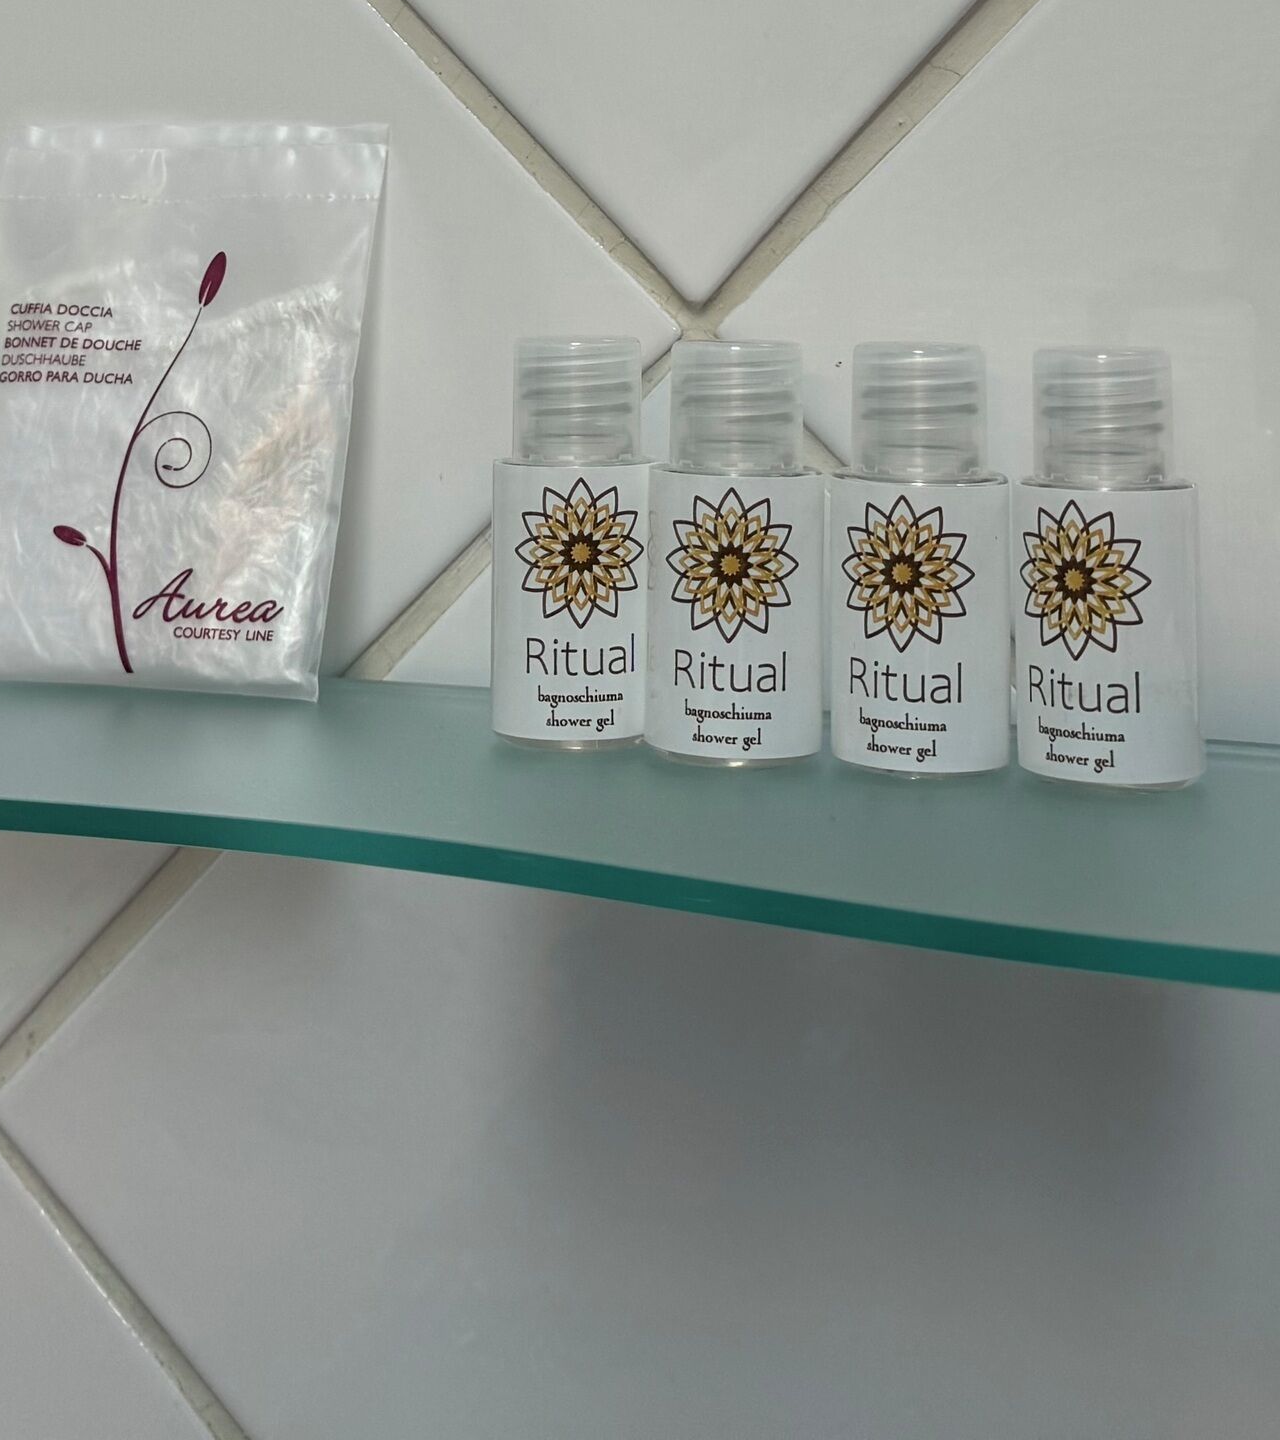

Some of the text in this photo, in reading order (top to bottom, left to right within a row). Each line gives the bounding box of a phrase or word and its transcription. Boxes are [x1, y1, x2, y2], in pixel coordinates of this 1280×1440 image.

[11, 303, 112, 318] CUFFIA DOCCIA
[8, 320, 92, 332] SHOWER CAP
[5, 337, 142, 350] BONNET DE DOUCHE
[2, 354, 86, 366] DUSCHHAUBE
[0, 371, 133, 384] GORRO PARA DUCHA
[133, 568, 284, 623] Aurea
[173, 627, 274, 641] COURTESY LINE
[526, 633, 634, 676] Ritual
[674, 649, 786, 692] Ritual
[850, 656, 962, 704] Ritual
[538, 685, 623, 708] bagnoschiuma
[1029, 664, 1140, 713] Ritual
[546, 709, 614, 732] shower gel
[685, 698, 772, 723] bagnoschiuma
[860, 707, 947, 732] bagnoschiuma
[692, 725, 762, 751] shower gel
[1039, 716, 1125, 742] bagnoschiuma
[867, 734, 936, 762] shower gel
[1046, 744, 1115, 773] shower gel
